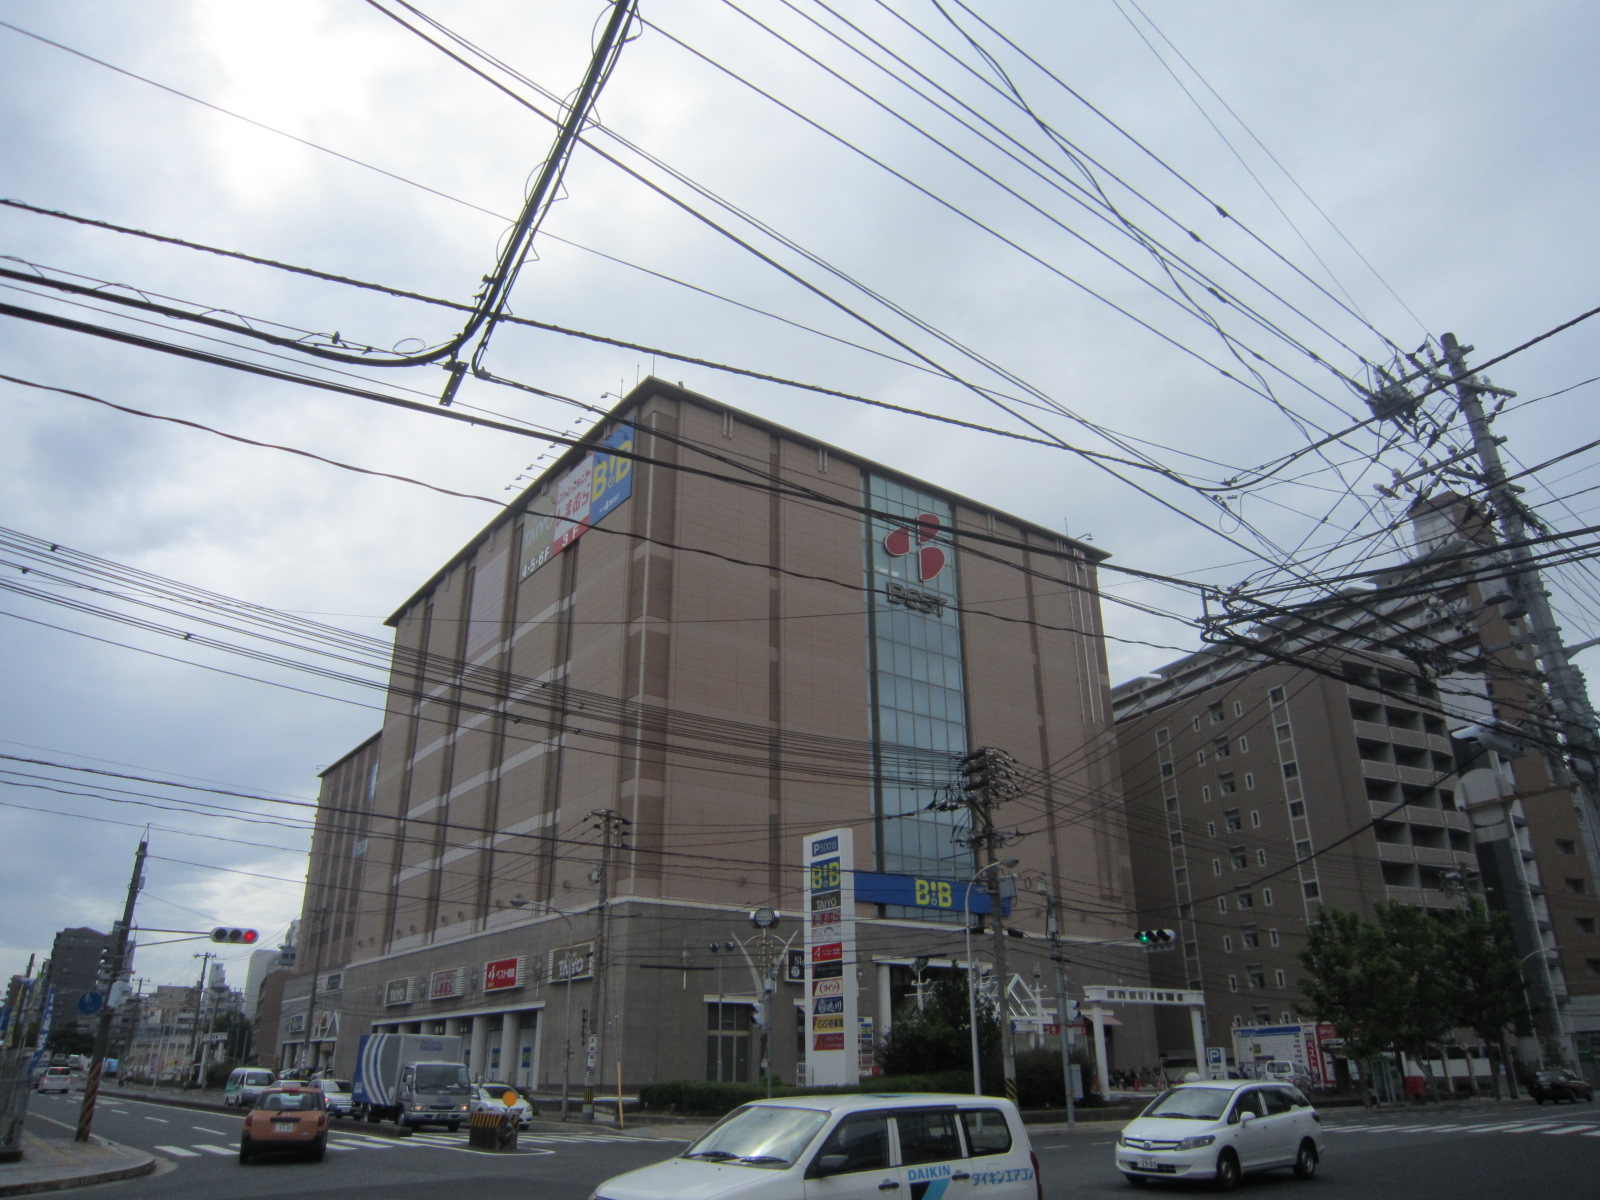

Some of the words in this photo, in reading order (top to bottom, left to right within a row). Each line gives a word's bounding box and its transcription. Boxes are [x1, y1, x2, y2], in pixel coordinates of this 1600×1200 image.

[555, 483, 590, 527] しまむら
[816, 897, 837, 910] TAIYO
[907, 1165, 951, 1182] DAIKIN
[971, 1167, 1034, 1187] ダイキンエアコン
